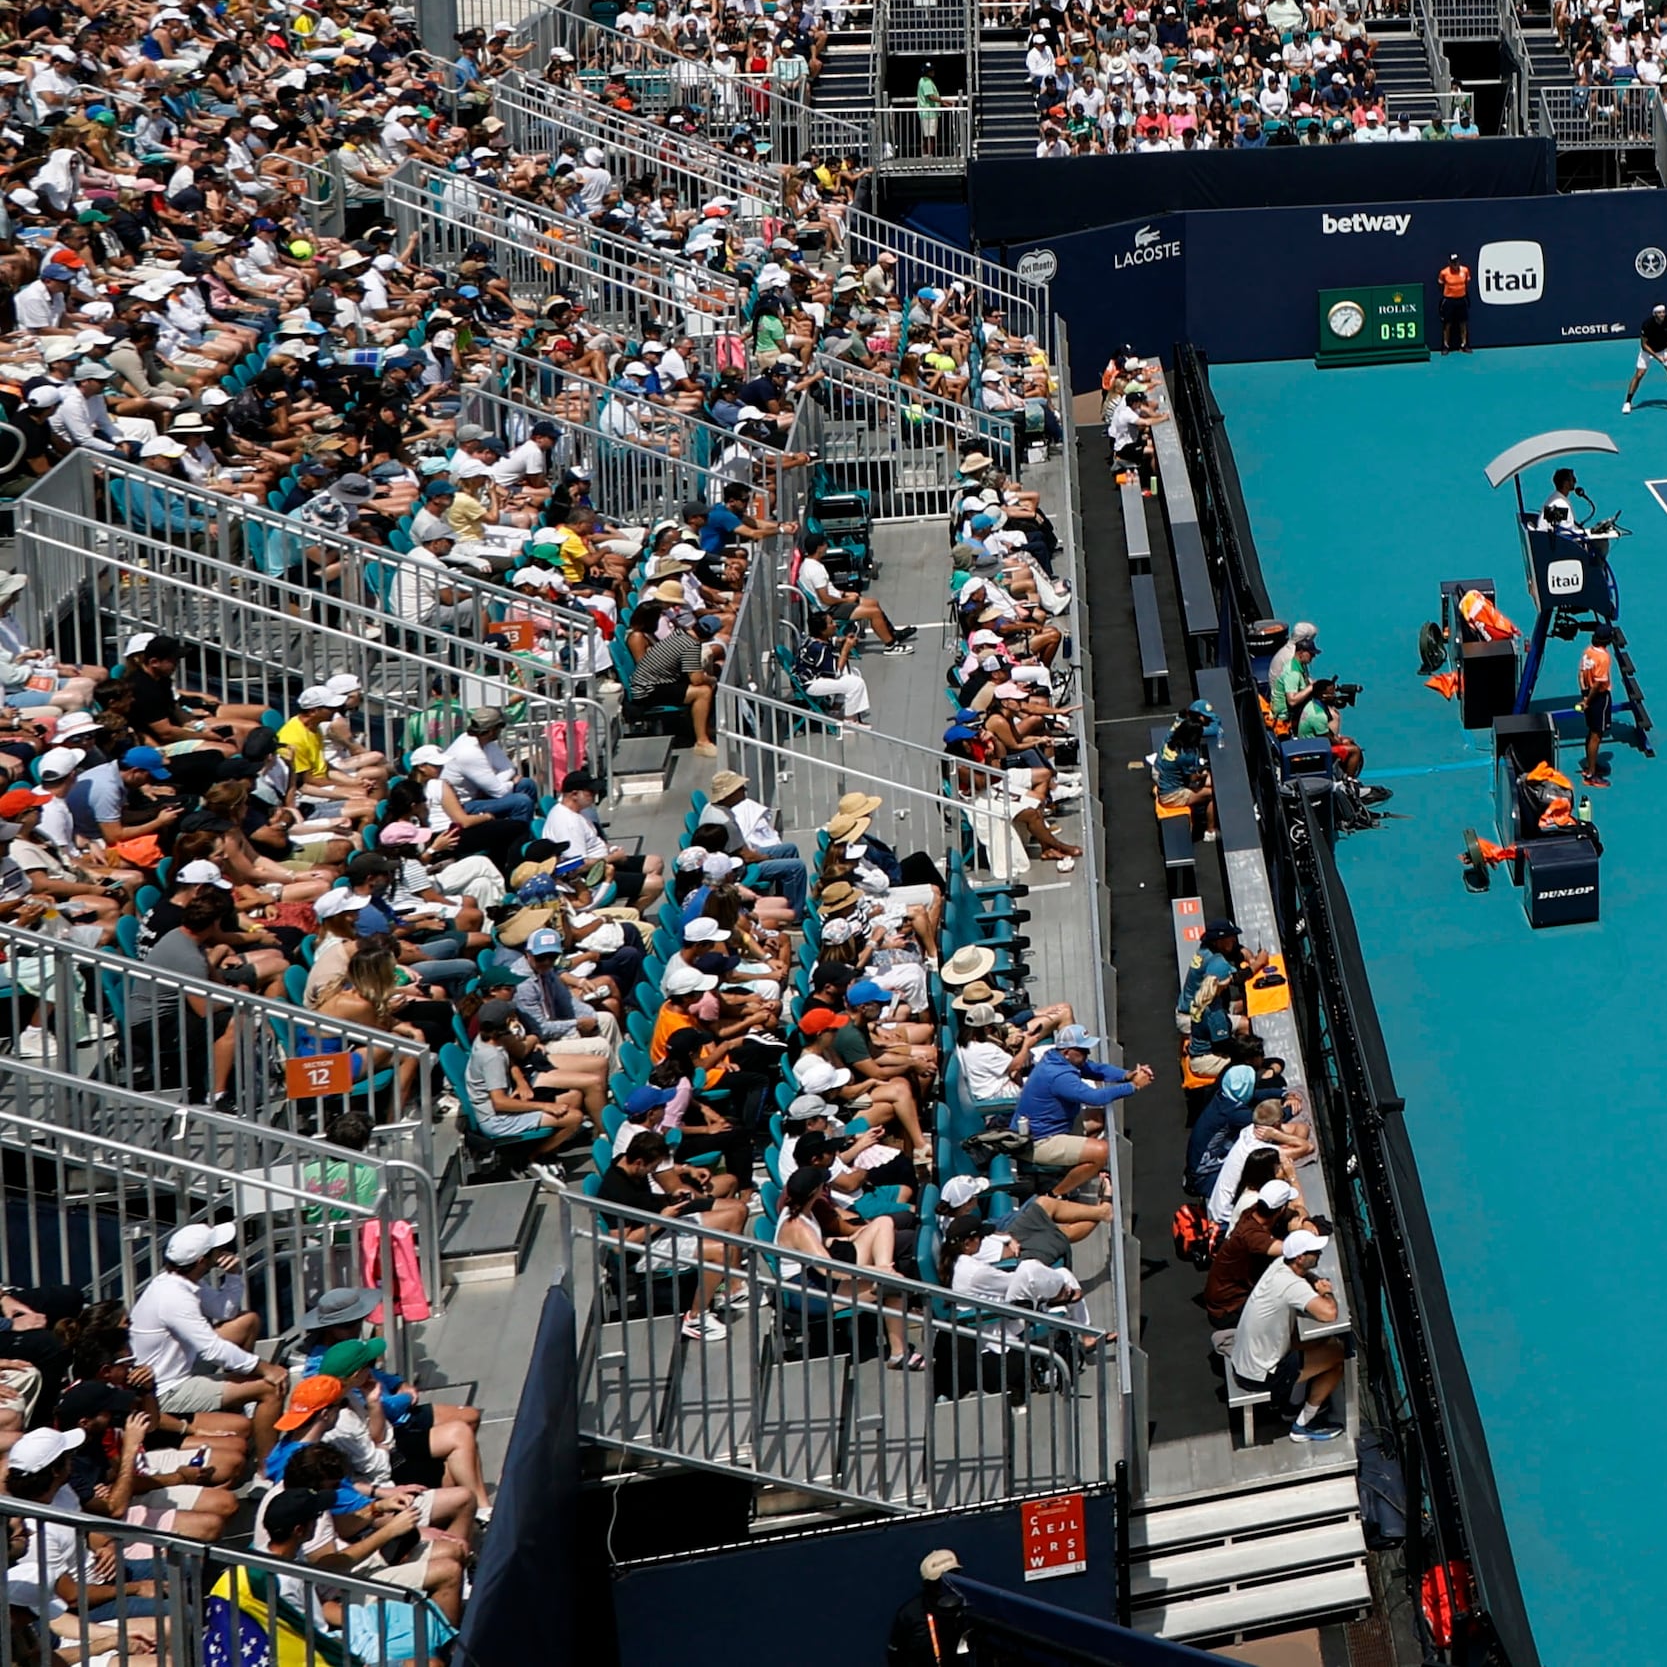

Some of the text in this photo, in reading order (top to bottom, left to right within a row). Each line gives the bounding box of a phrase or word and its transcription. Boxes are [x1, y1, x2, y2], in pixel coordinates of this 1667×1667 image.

[1322, 214, 1411, 236] betway
[1114, 241, 1181, 269] LACOSTE
[1021, 260, 1053, 275] Del Monte
[1485, 268, 1537, 292] itaú
[1378, 304, 1417, 315] ROLEX
[1381, 322, 1416, 340] 0:53
[1560, 324, 1608, 336] LACOSTE
[1552, 574, 1579, 588] itaú
[503, 631, 519, 643] 13
[1538, 886, 1594, 899] DUNLOP
[302, 1059, 334, 1069] SECTION
[307, 1068, 331, 1086] 12
[1030, 1515, 1038, 1526] C
[1030, 1526, 1041, 1537] A
[1047, 1523, 1055, 1534] E
[1069, 1519, 1078, 1530] L
[1030, 1555, 1045, 1568] W
